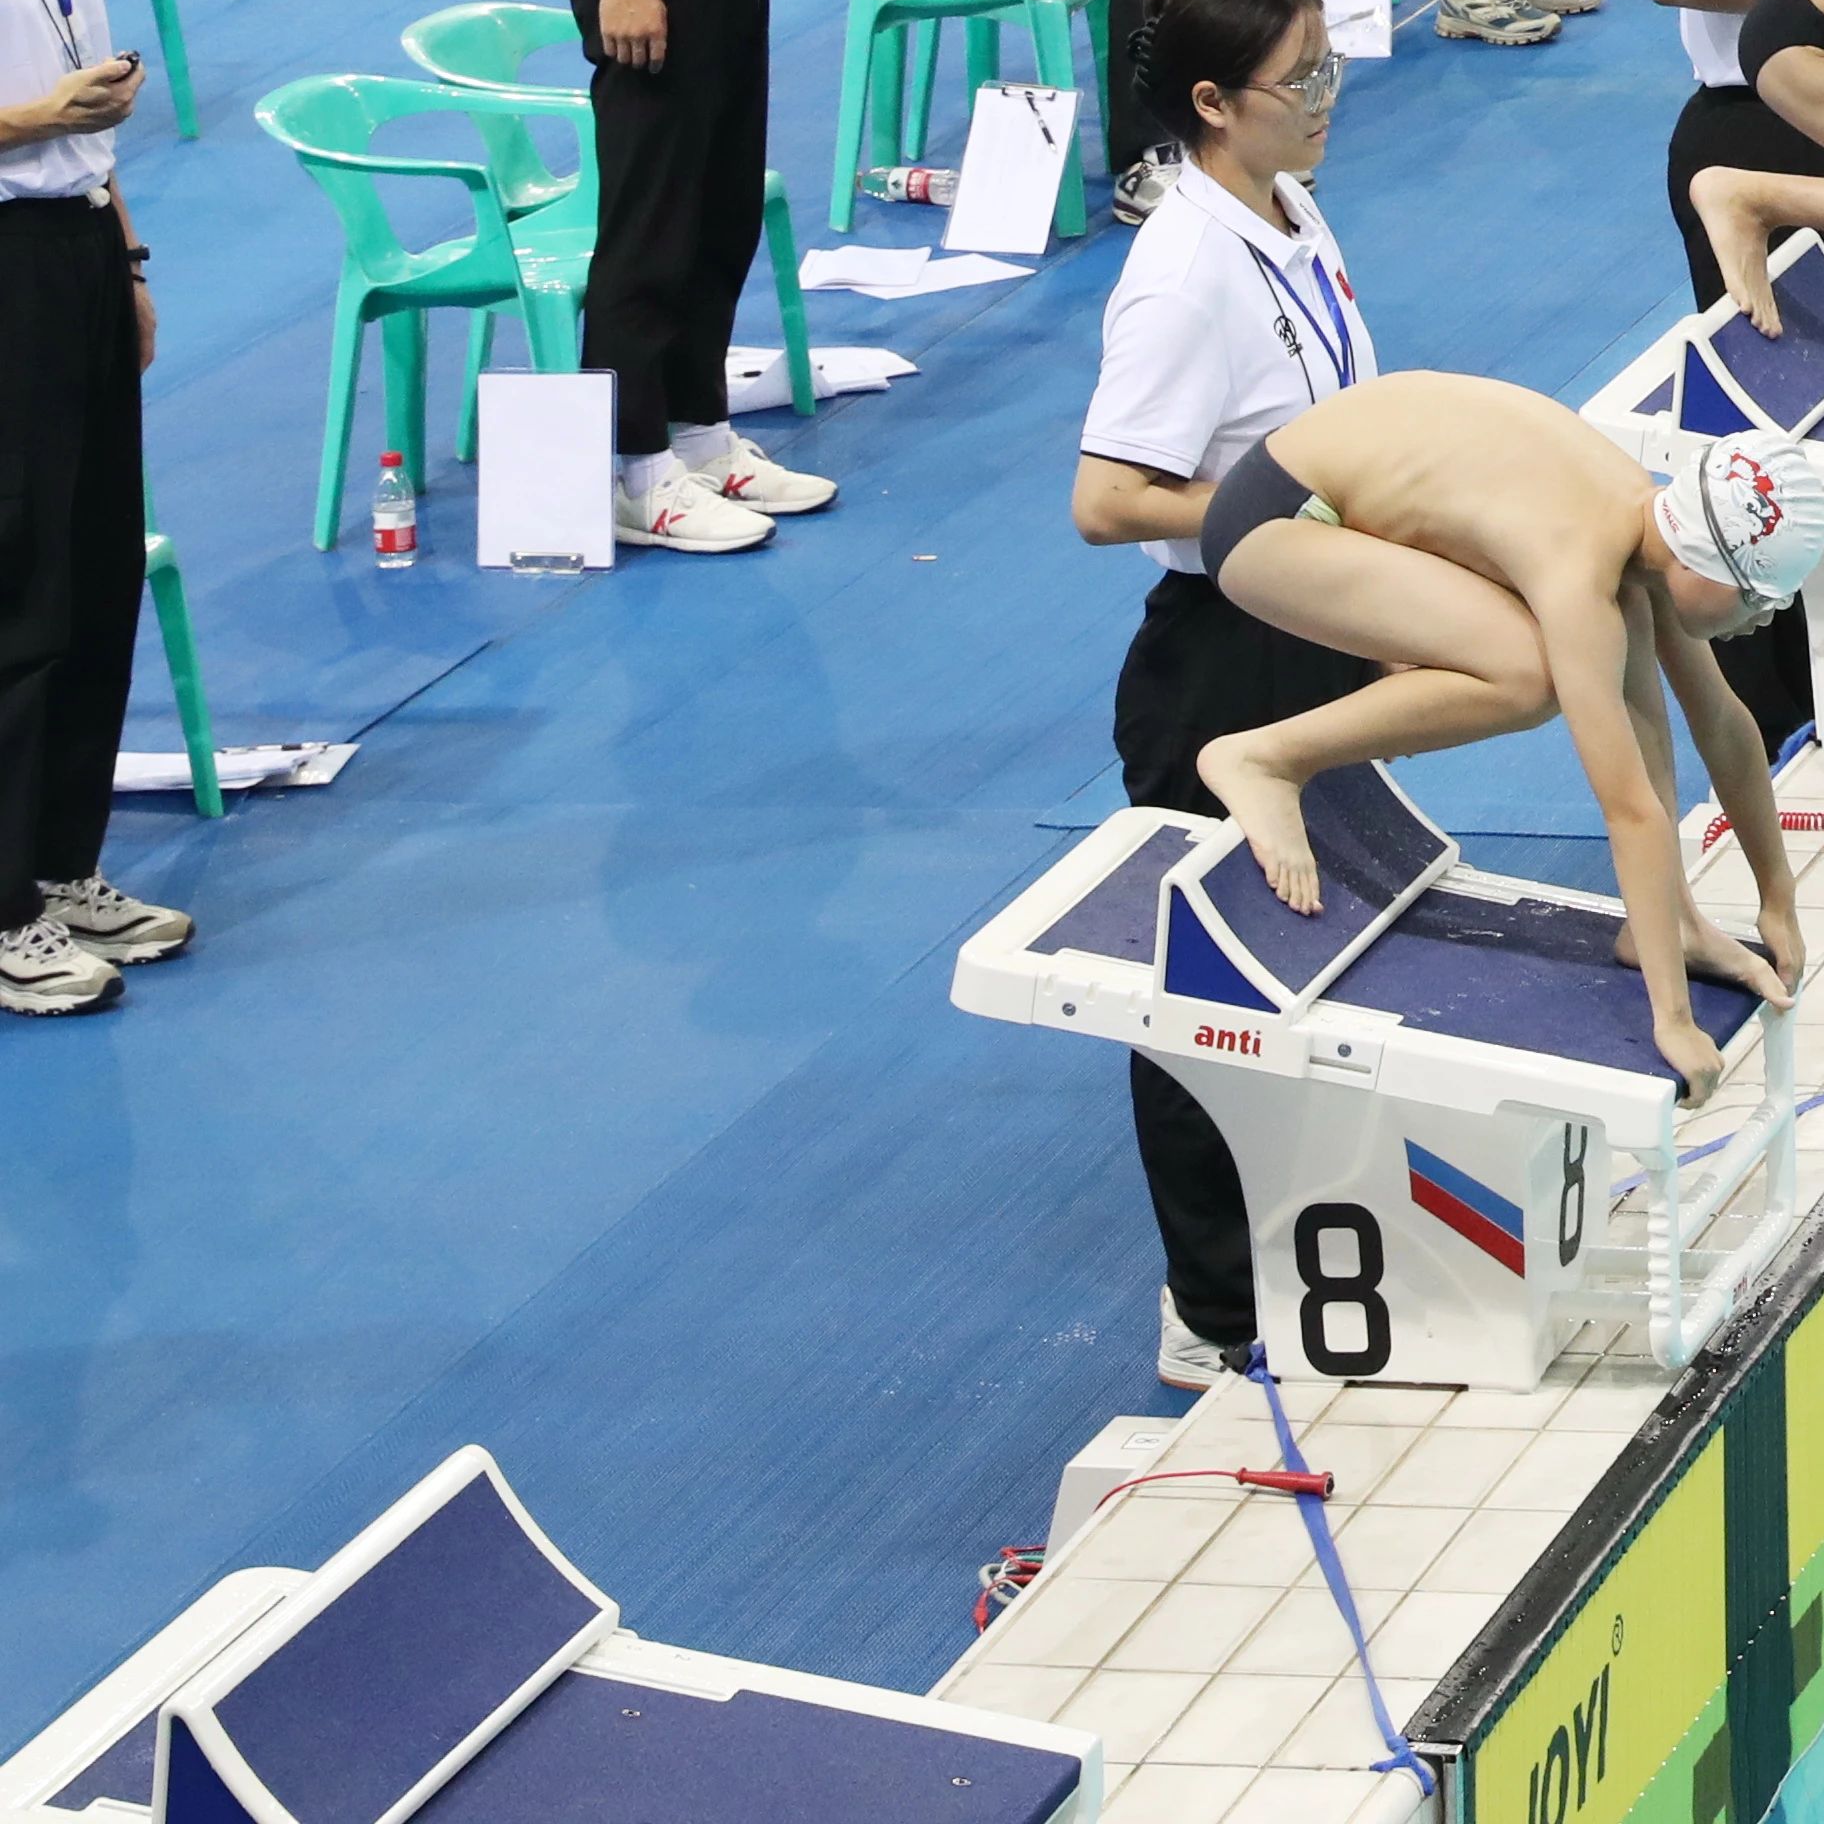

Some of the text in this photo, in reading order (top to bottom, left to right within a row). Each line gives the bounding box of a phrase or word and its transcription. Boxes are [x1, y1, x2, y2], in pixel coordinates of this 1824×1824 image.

[1194, 1024, 1262, 1058] anti
[1558, 1122, 1588, 1267] 8
[1294, 1202, 1392, 1377] 8
